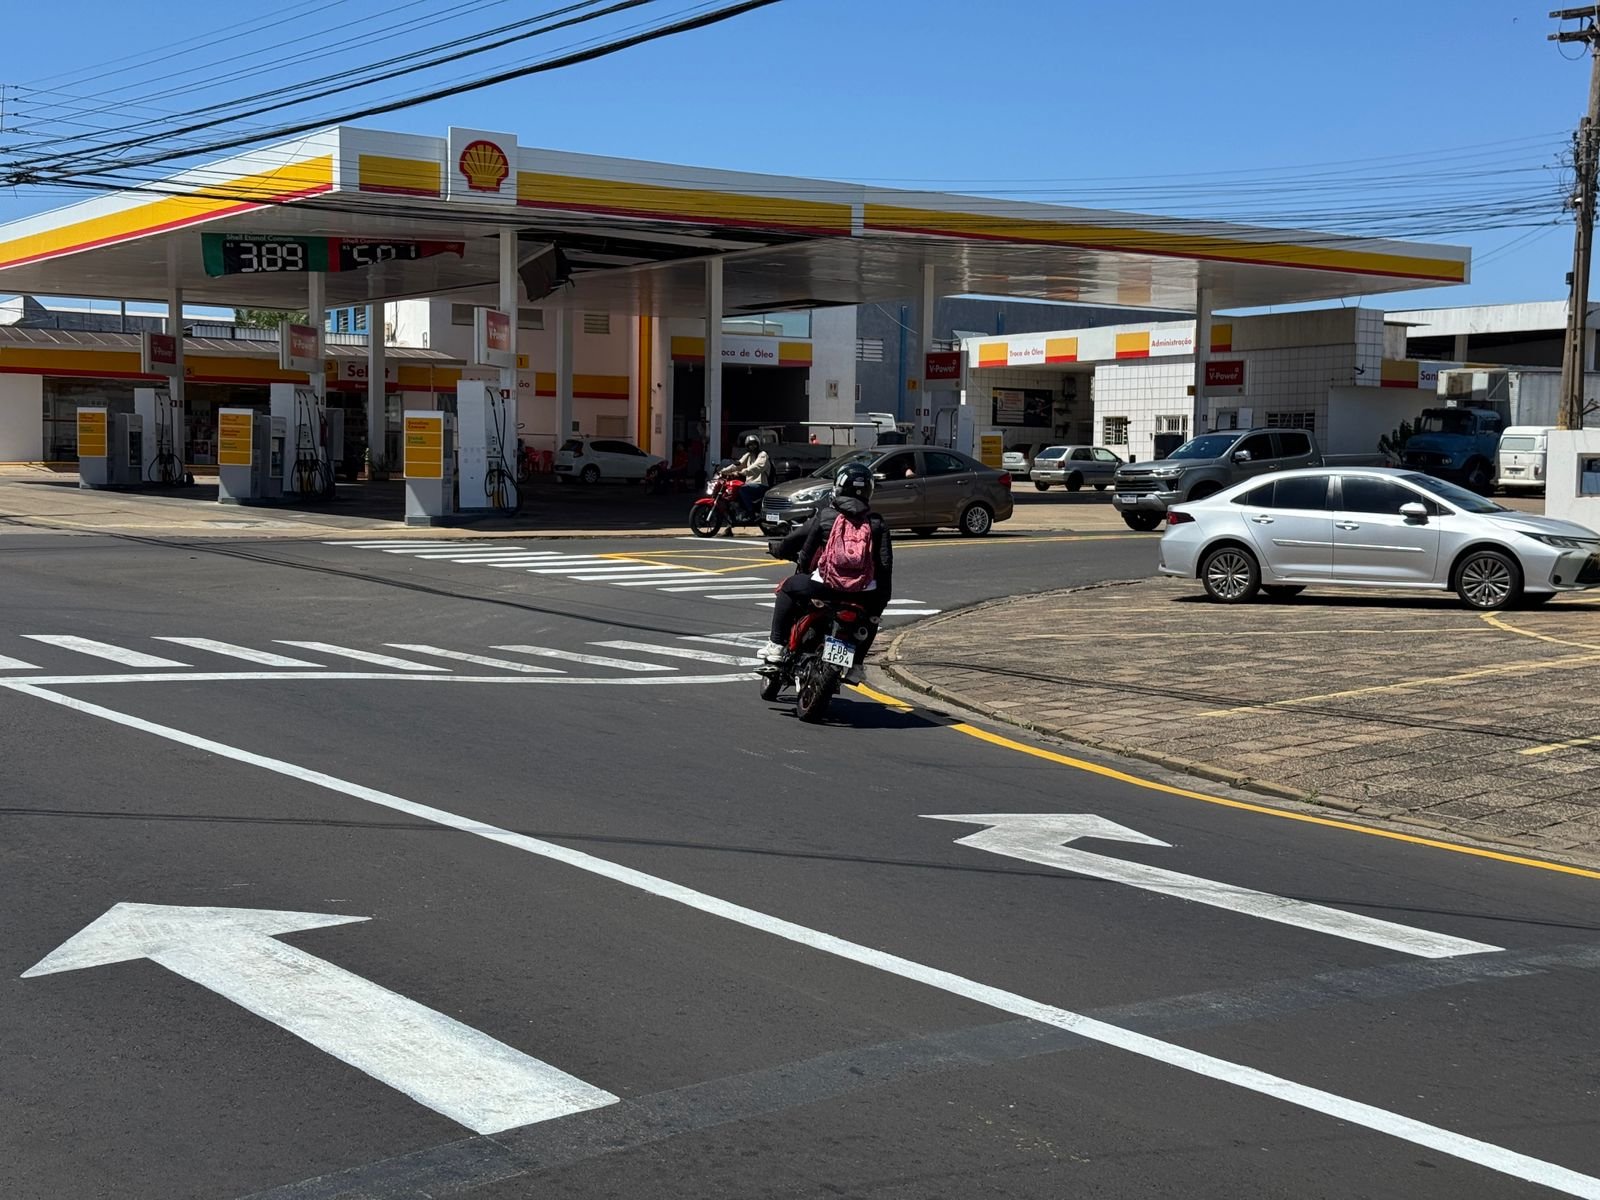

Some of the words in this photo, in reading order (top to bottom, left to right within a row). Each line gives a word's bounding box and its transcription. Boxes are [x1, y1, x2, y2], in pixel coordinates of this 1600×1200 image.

[1151, 336, 1192, 347] Administração
[721, 349, 736, 357] oca
[740, 348, 750, 357] de
[754, 347, 774, 359] Óleo
[1009, 350, 1023, 358] Troca
[1031, 347, 1044, 356] Óleo
[929, 364, 956, 373] V-Power
[1208, 371, 1238, 381] V-Power
